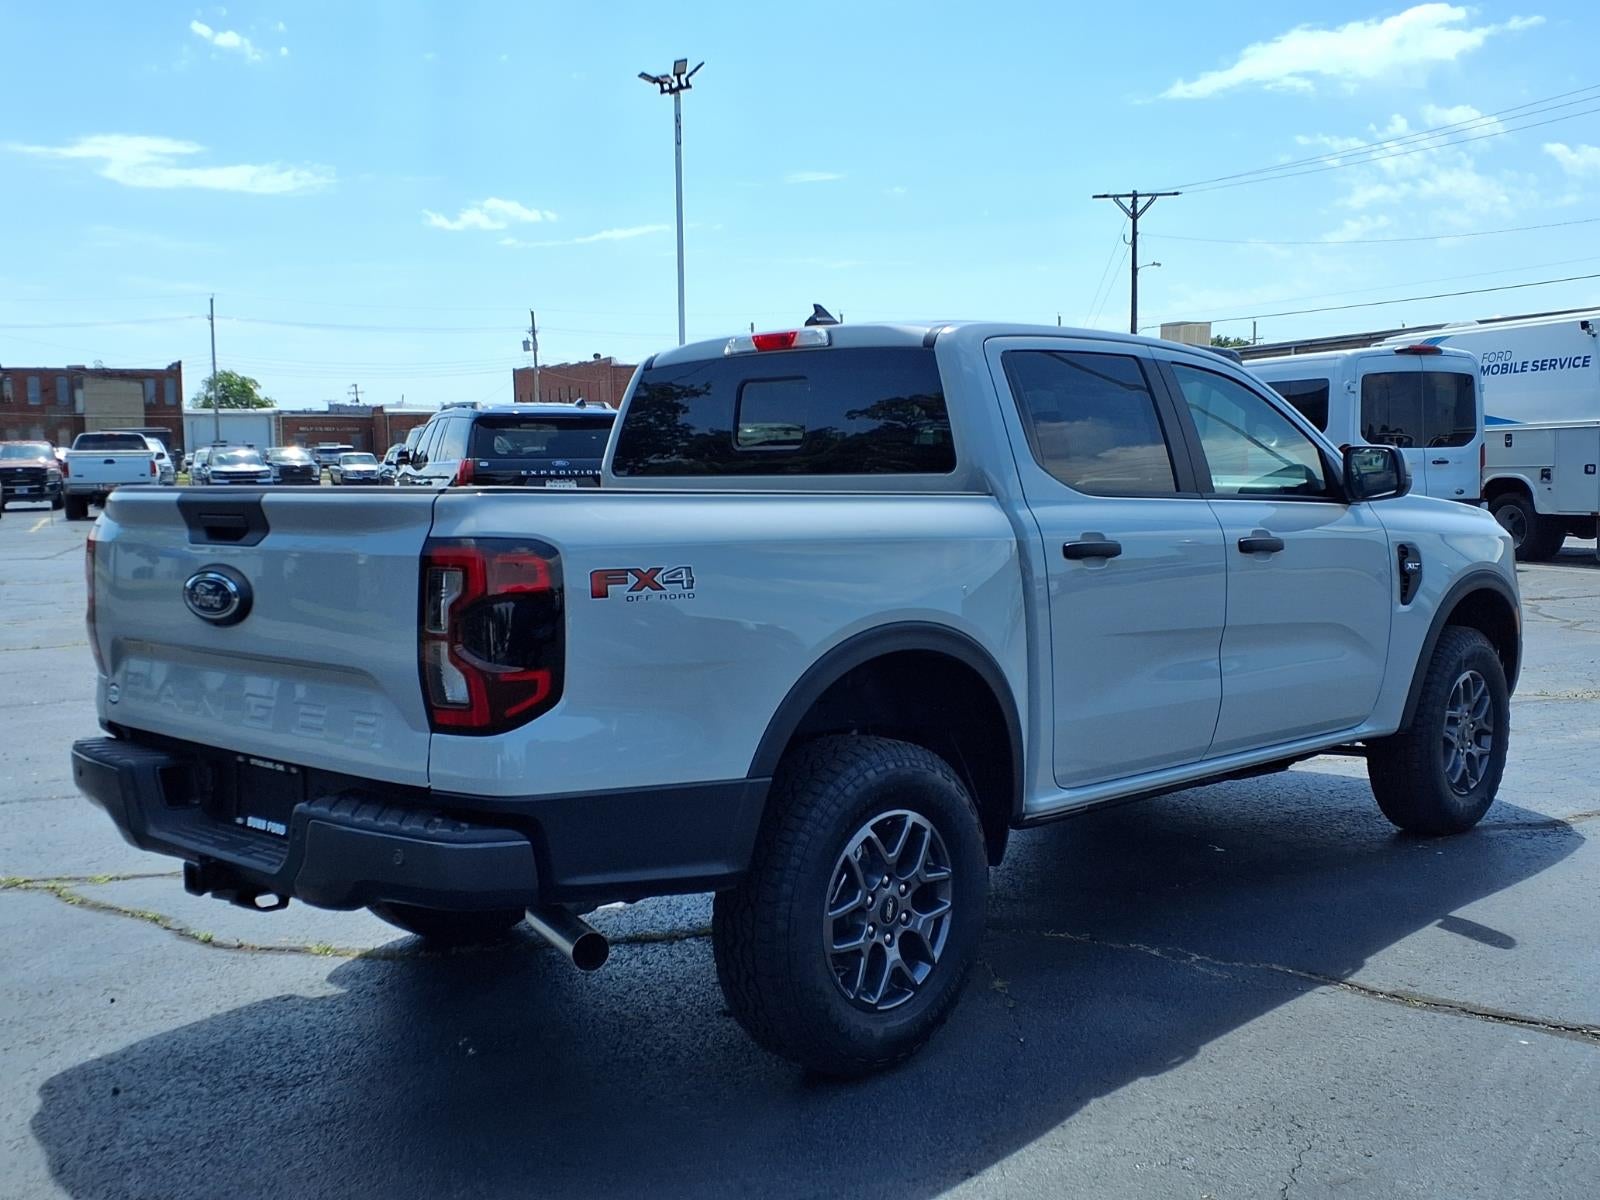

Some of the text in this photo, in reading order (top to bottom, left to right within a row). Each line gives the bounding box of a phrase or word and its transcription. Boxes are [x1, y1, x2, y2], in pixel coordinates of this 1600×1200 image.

[1481, 350, 1513, 363] FORD
[1480, 355, 1592, 376] MOBILE SERVICE
[589, 565, 695, 599] FX4
[659, 592, 696, 601] ROAD
